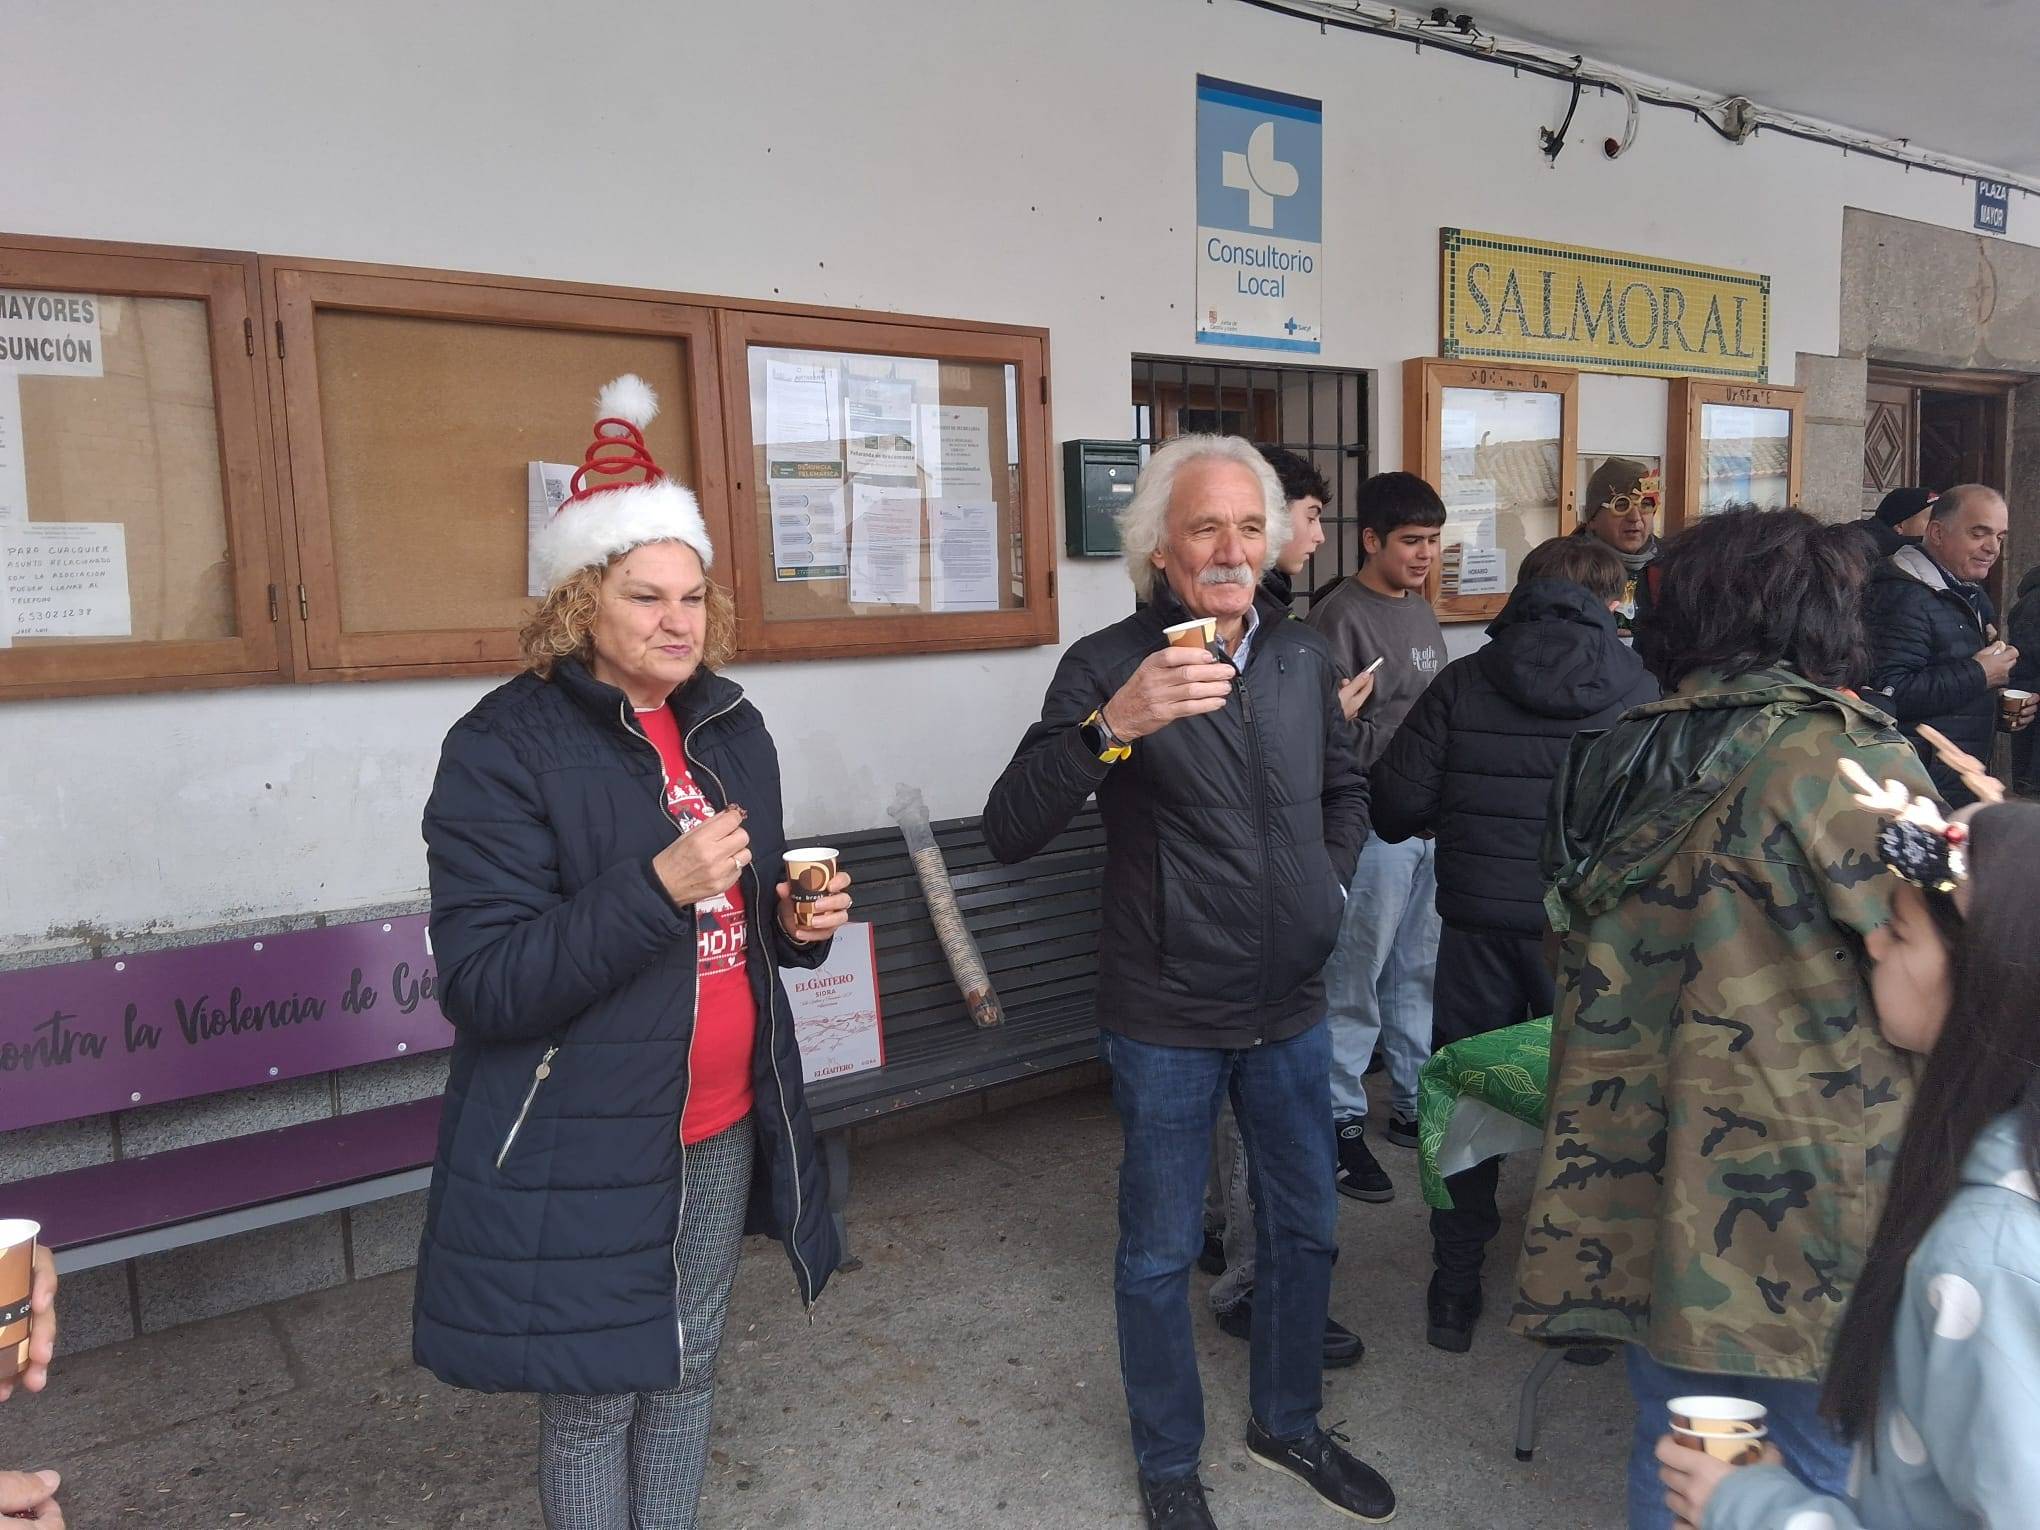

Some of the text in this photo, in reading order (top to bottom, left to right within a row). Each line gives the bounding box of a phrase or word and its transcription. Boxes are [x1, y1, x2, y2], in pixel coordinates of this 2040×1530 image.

[1979, 180, 2007, 200] PLAZA
[1980, 204, 2004, 227] MAYOR
[1207, 237, 1313, 274] Consultorio
[1237, 270, 1285, 298] Local
[1464, 262, 1755, 359] SALMORAL
[815, 988, 837, 998] SIDRA
[123, 1003, 163, 1053] la
[174, 985, 328, 1045] Violencia
[341, 967, 378, 1015] de
